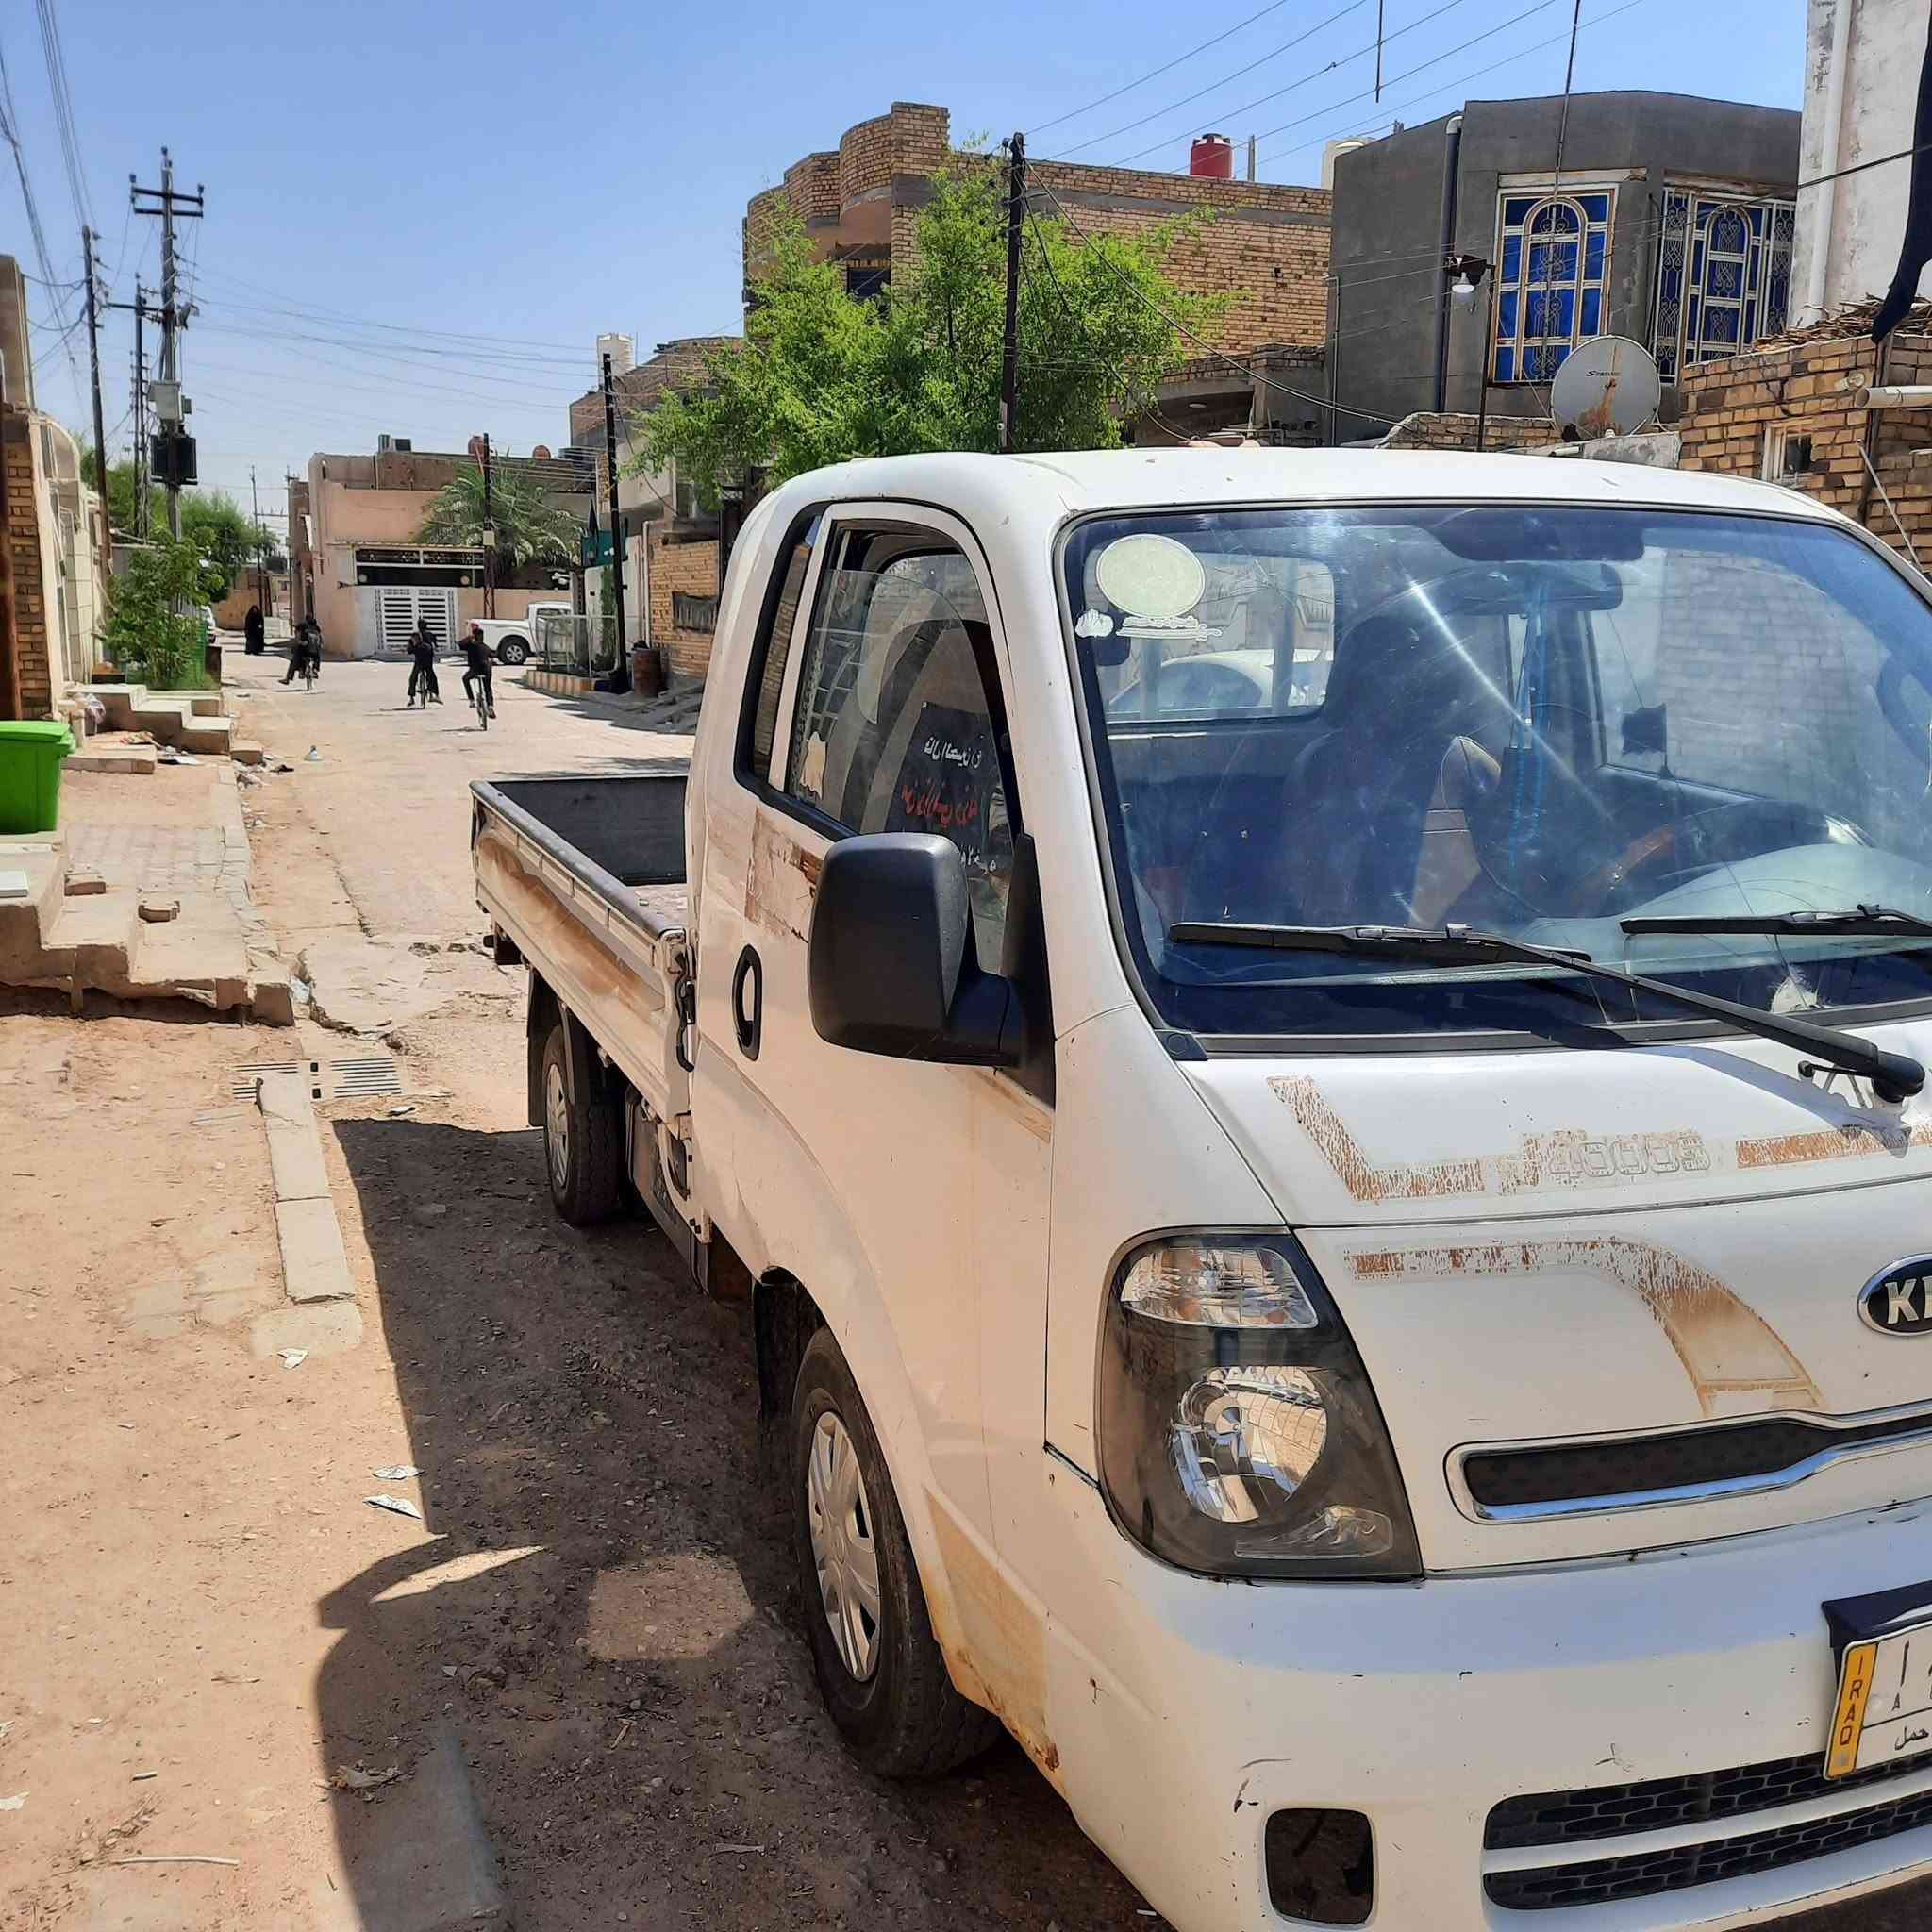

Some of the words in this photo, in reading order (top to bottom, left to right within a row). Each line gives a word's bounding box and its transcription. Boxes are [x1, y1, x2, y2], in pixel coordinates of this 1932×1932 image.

[1840, 1654, 1863, 1745] IRAQ
[1891, 1692, 1901, 1711] A
[1894, 1726, 1929, 1751] حمل
